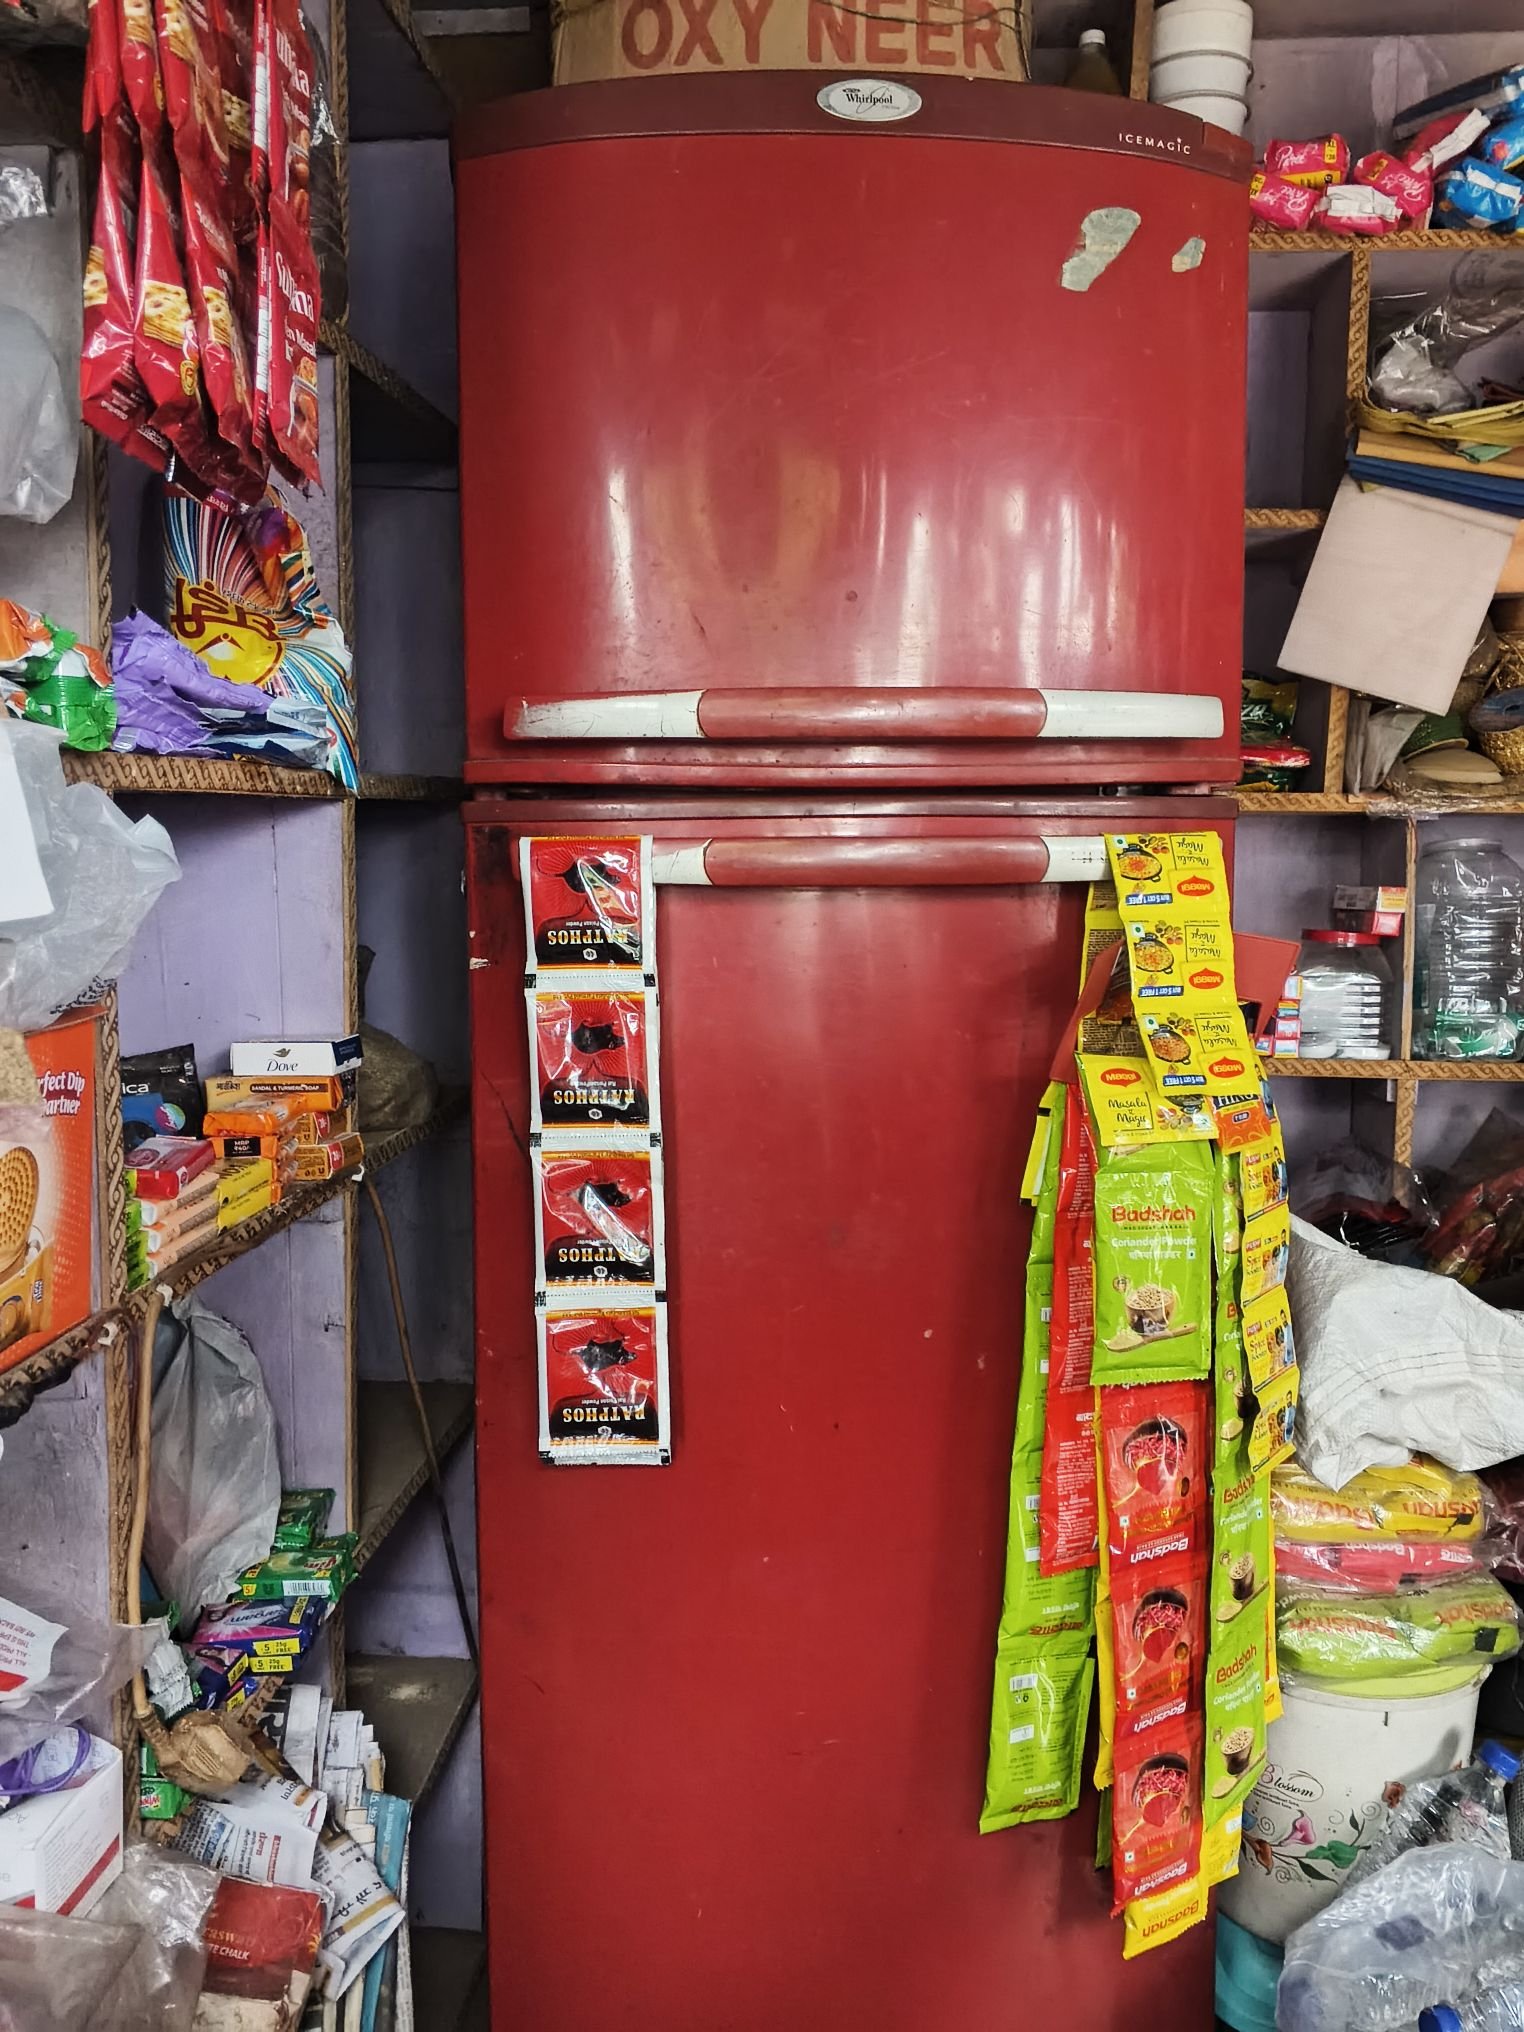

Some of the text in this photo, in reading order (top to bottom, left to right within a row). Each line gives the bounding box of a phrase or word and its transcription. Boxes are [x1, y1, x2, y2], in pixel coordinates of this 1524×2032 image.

[621, 0, 1005, 71] OXY NEER
[845, 93, 893, 106] Whirlpool
[1118, 132, 1191, 155] ICEMAGIC
[266, 1059, 299, 1072] Dove
[67, 1070, 86, 1098] Dip
[553, 1089, 635, 1105] RATPHOS
[1108, 1097, 1148, 1108] Masala
[1111, 1205, 1196, 1222] Badshah
[558, 1248, 632, 1262] ATPHOS
[563, 1406, 645, 1423] RATPHOS
[1130, 1537, 1189, 1564] Badshah
[1215, 1643, 1257, 1685] Badshah
[1133, 1701, 1187, 1734] Badshah
[1261, 1764, 1315, 1798] Blossom
[1134, 1861, 1188, 1896] Badshah
[1142, 1900, 1199, 1938] Badshah
[219, 1945, 250, 1961] CHALK
